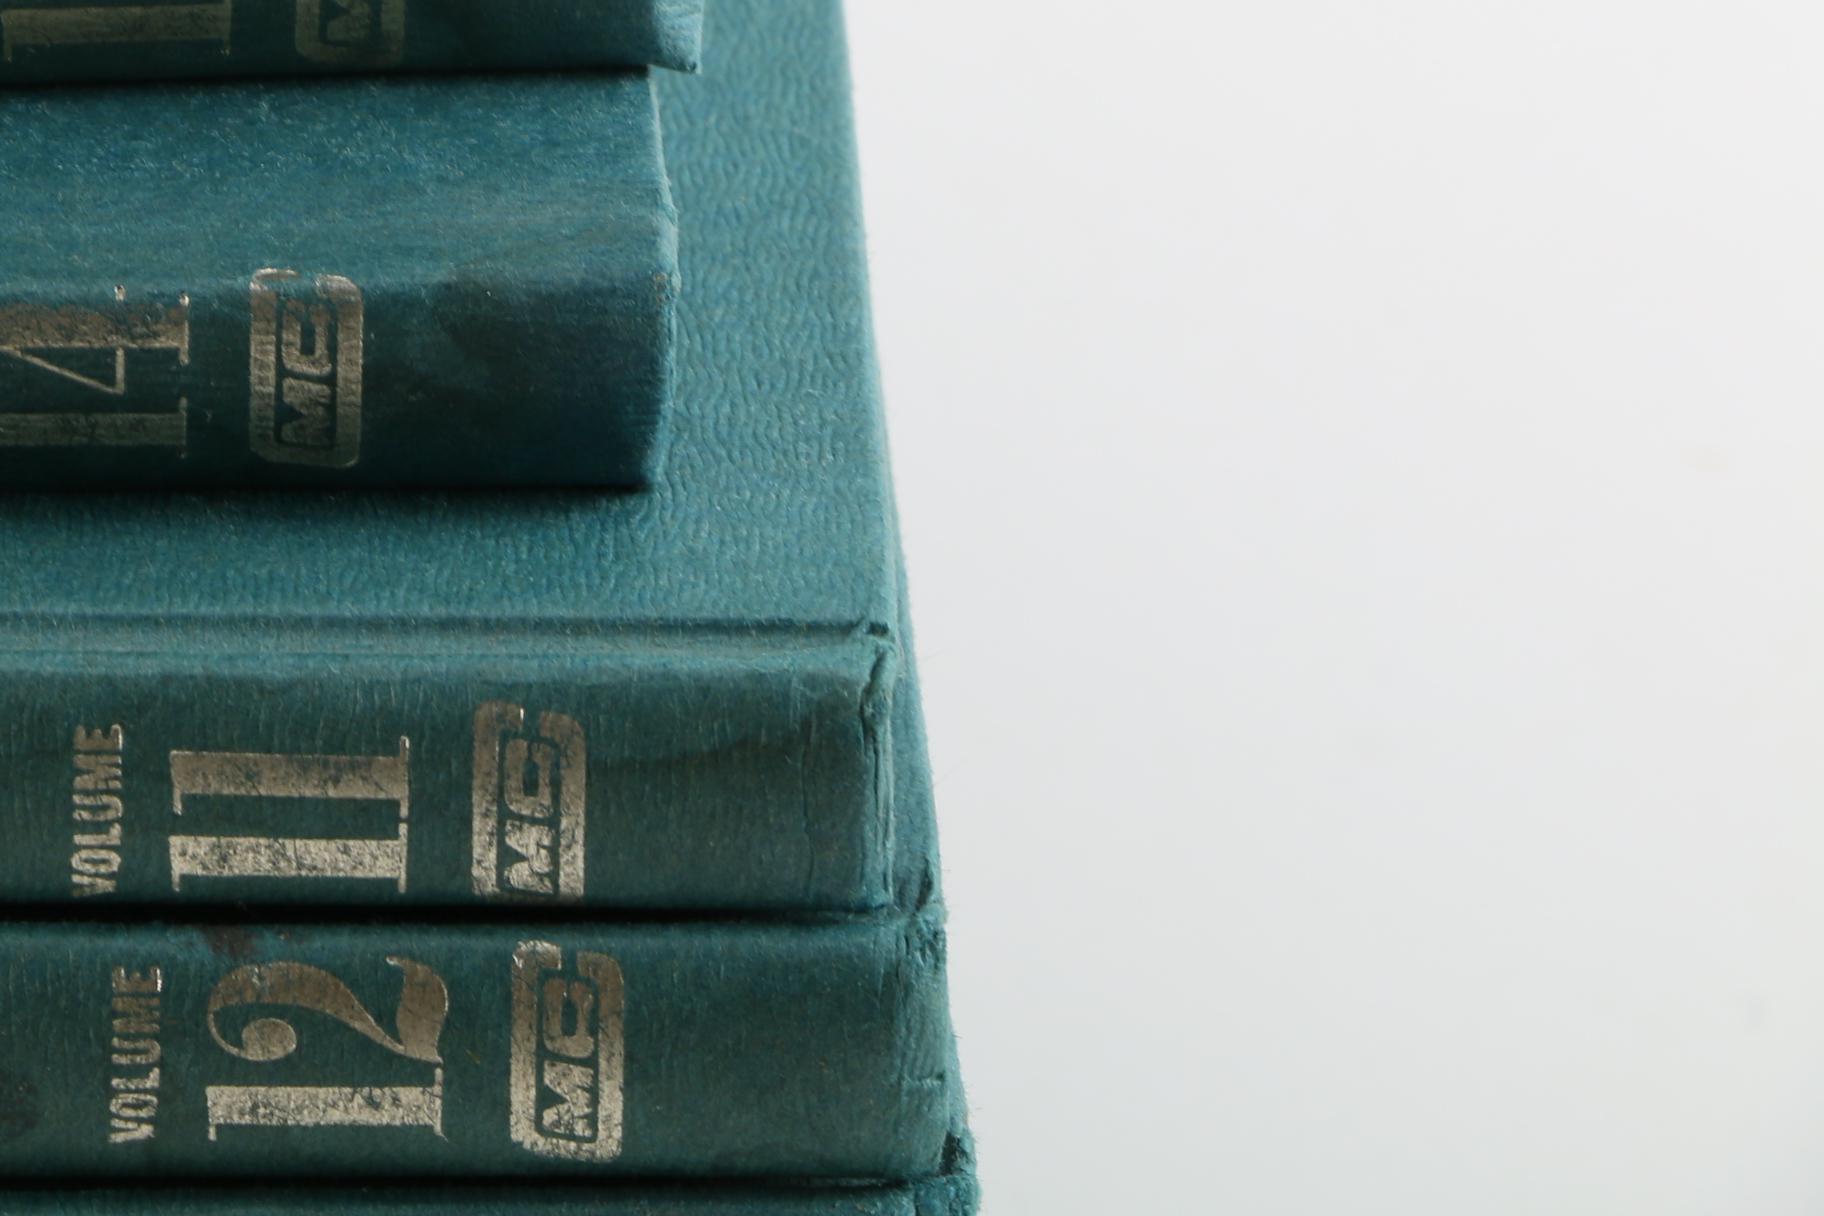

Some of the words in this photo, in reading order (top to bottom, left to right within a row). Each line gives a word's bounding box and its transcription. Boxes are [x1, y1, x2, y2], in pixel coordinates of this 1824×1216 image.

[69, 723, 124, 896] VOLUME
[168, 737, 411, 891] 11
[109, 966, 163, 1142] VOLUME
[205, 955, 449, 1140] 12
